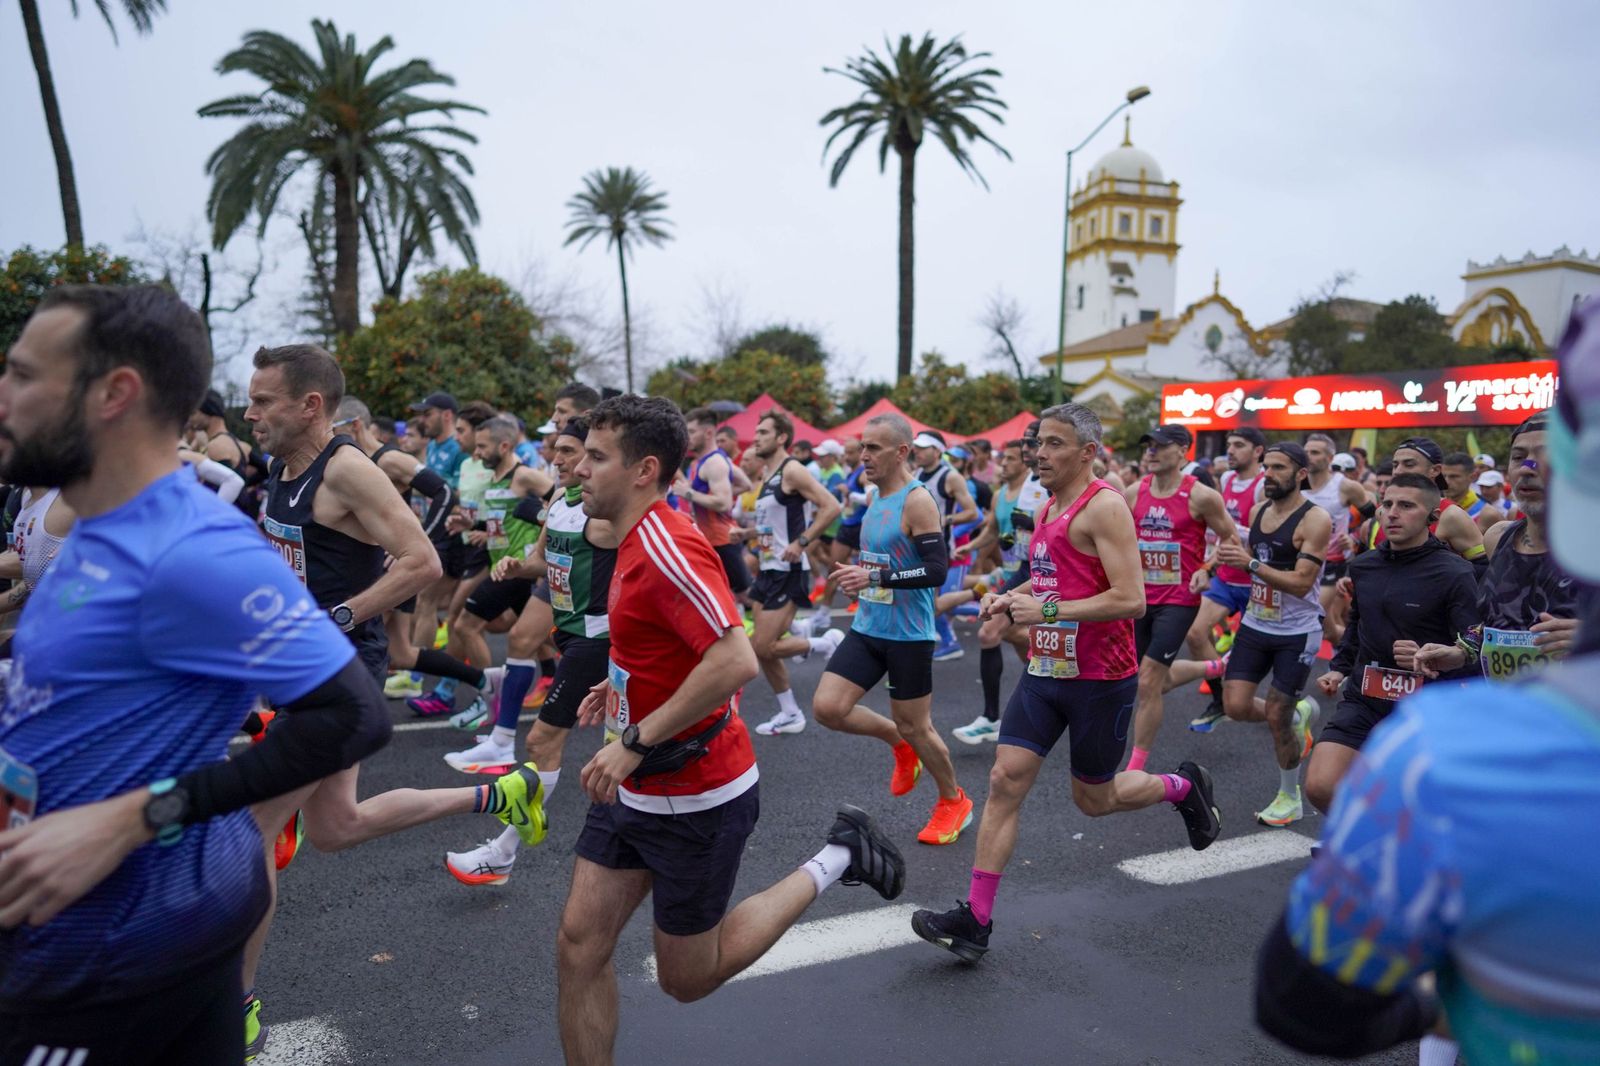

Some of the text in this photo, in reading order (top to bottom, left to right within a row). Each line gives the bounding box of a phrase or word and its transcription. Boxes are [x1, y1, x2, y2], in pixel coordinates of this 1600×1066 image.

[1473, 372, 1559, 396] marató
[1491, 389, 1557, 411] sevill
[1145, 553, 1167, 566] 310
[899, 567, 926, 579] TERREX
[1035, 630, 1059, 650] 828
[1381, 674, 1416, 695] 640
